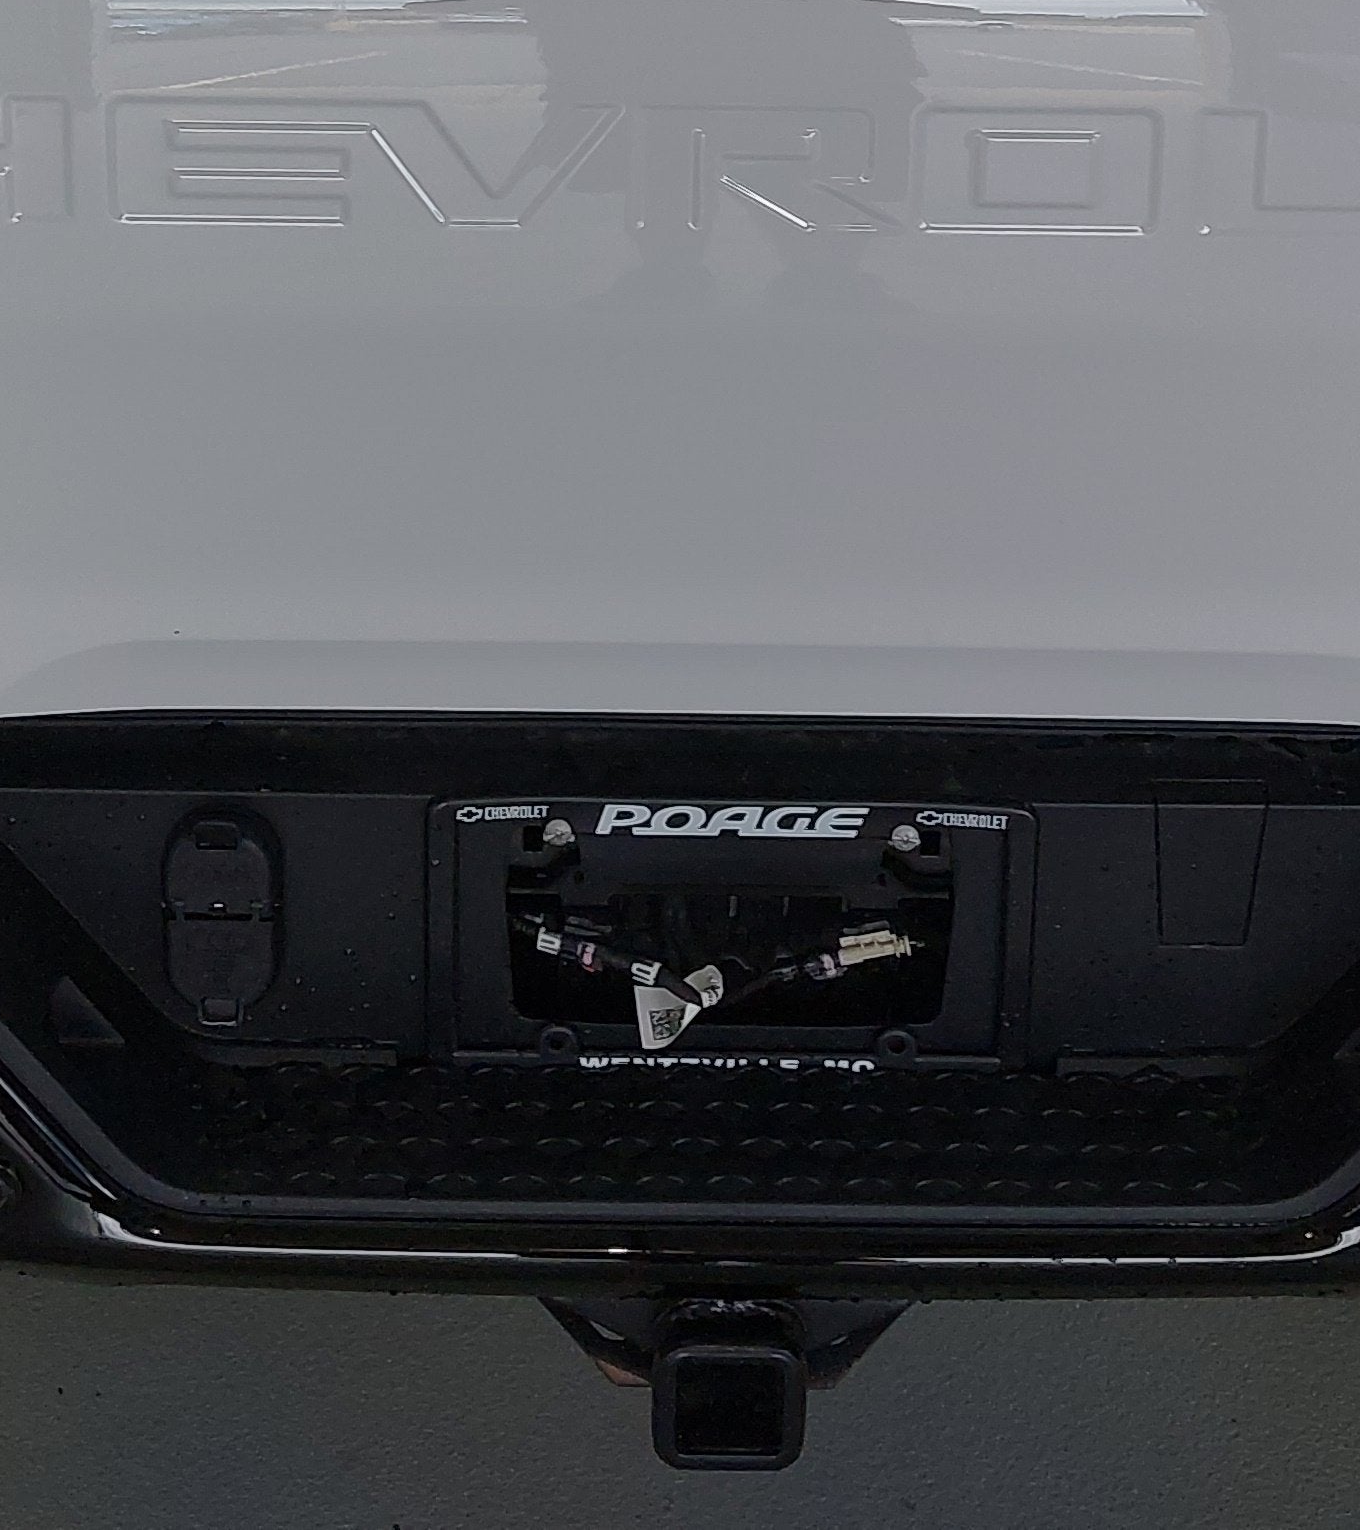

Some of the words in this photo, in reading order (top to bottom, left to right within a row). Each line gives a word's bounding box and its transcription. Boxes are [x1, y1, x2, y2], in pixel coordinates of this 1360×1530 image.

[483, 805, 550, 820] CHEVROLET
[594, 803, 871, 839] POAGE
[942, 812, 1009, 830] CHEVROLET
